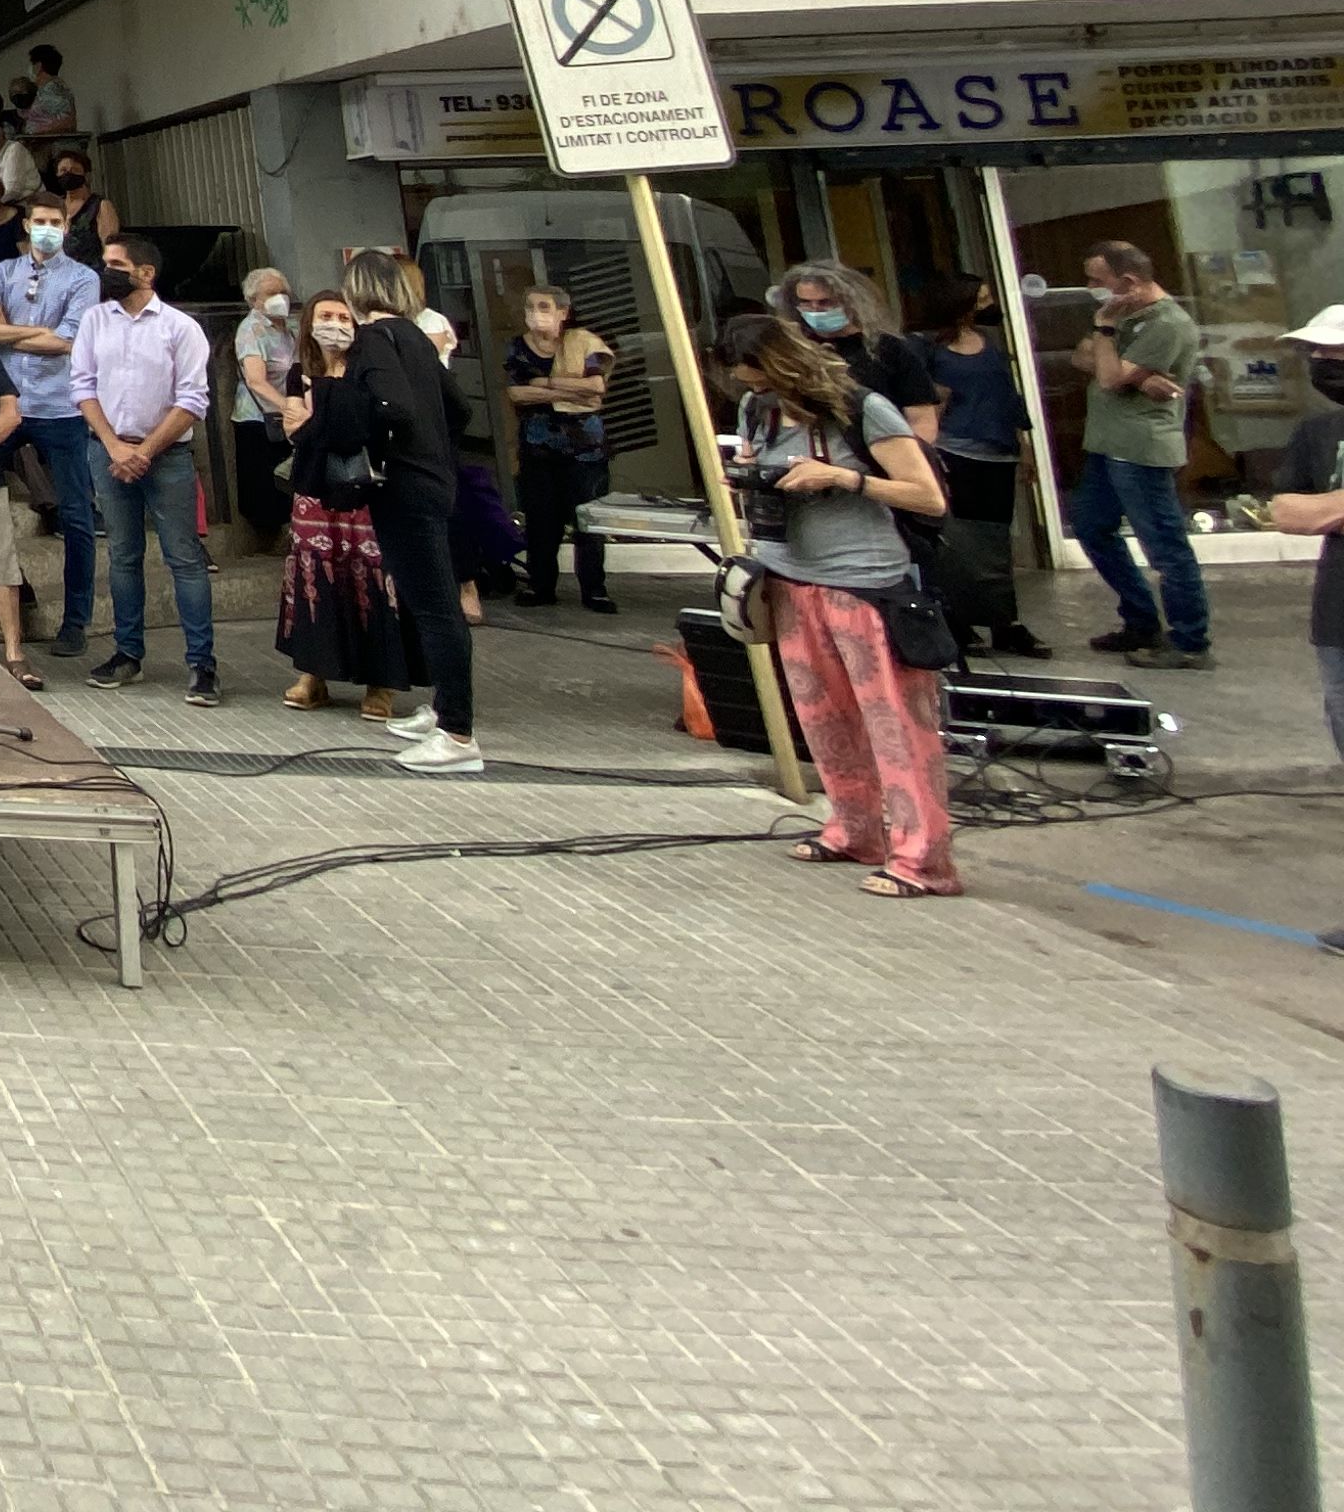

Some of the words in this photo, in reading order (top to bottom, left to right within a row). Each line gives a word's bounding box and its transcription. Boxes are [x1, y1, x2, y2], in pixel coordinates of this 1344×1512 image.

[582, 95, 596, 107] FI
[601, 93, 622, 106] DE
[626, 90, 668, 105] ZONA
[560, 106, 705, 129] D'ESTACIONAMENT
[556, 132, 612, 148] LIMITAT
[617, 132, 622, 144] I
[626, 125, 719, 144] CONTROLAT
